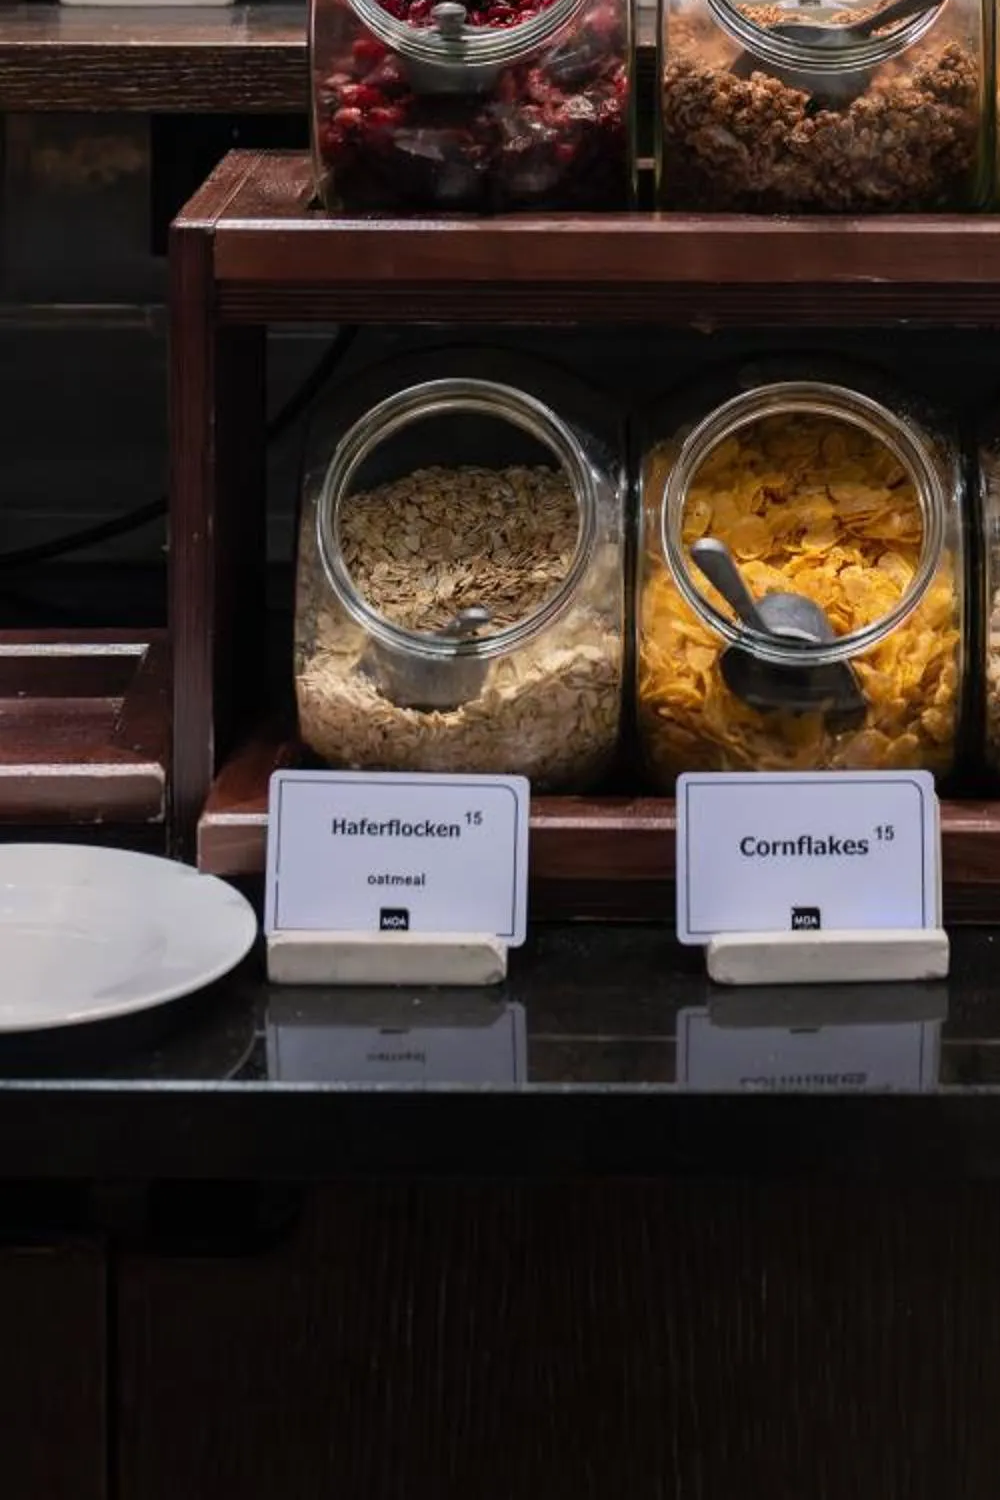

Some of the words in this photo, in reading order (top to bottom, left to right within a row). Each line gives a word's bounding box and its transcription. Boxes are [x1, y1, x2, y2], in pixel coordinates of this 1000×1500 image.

[332, 819, 460, 838] Haferflocken
[465, 812, 482, 826] 15
[740, 836, 869, 857] Cornflakes
[874, 826, 894, 841] 15
[367, 873, 426, 887] oatmeal
[382, 916, 407, 926] MOA
